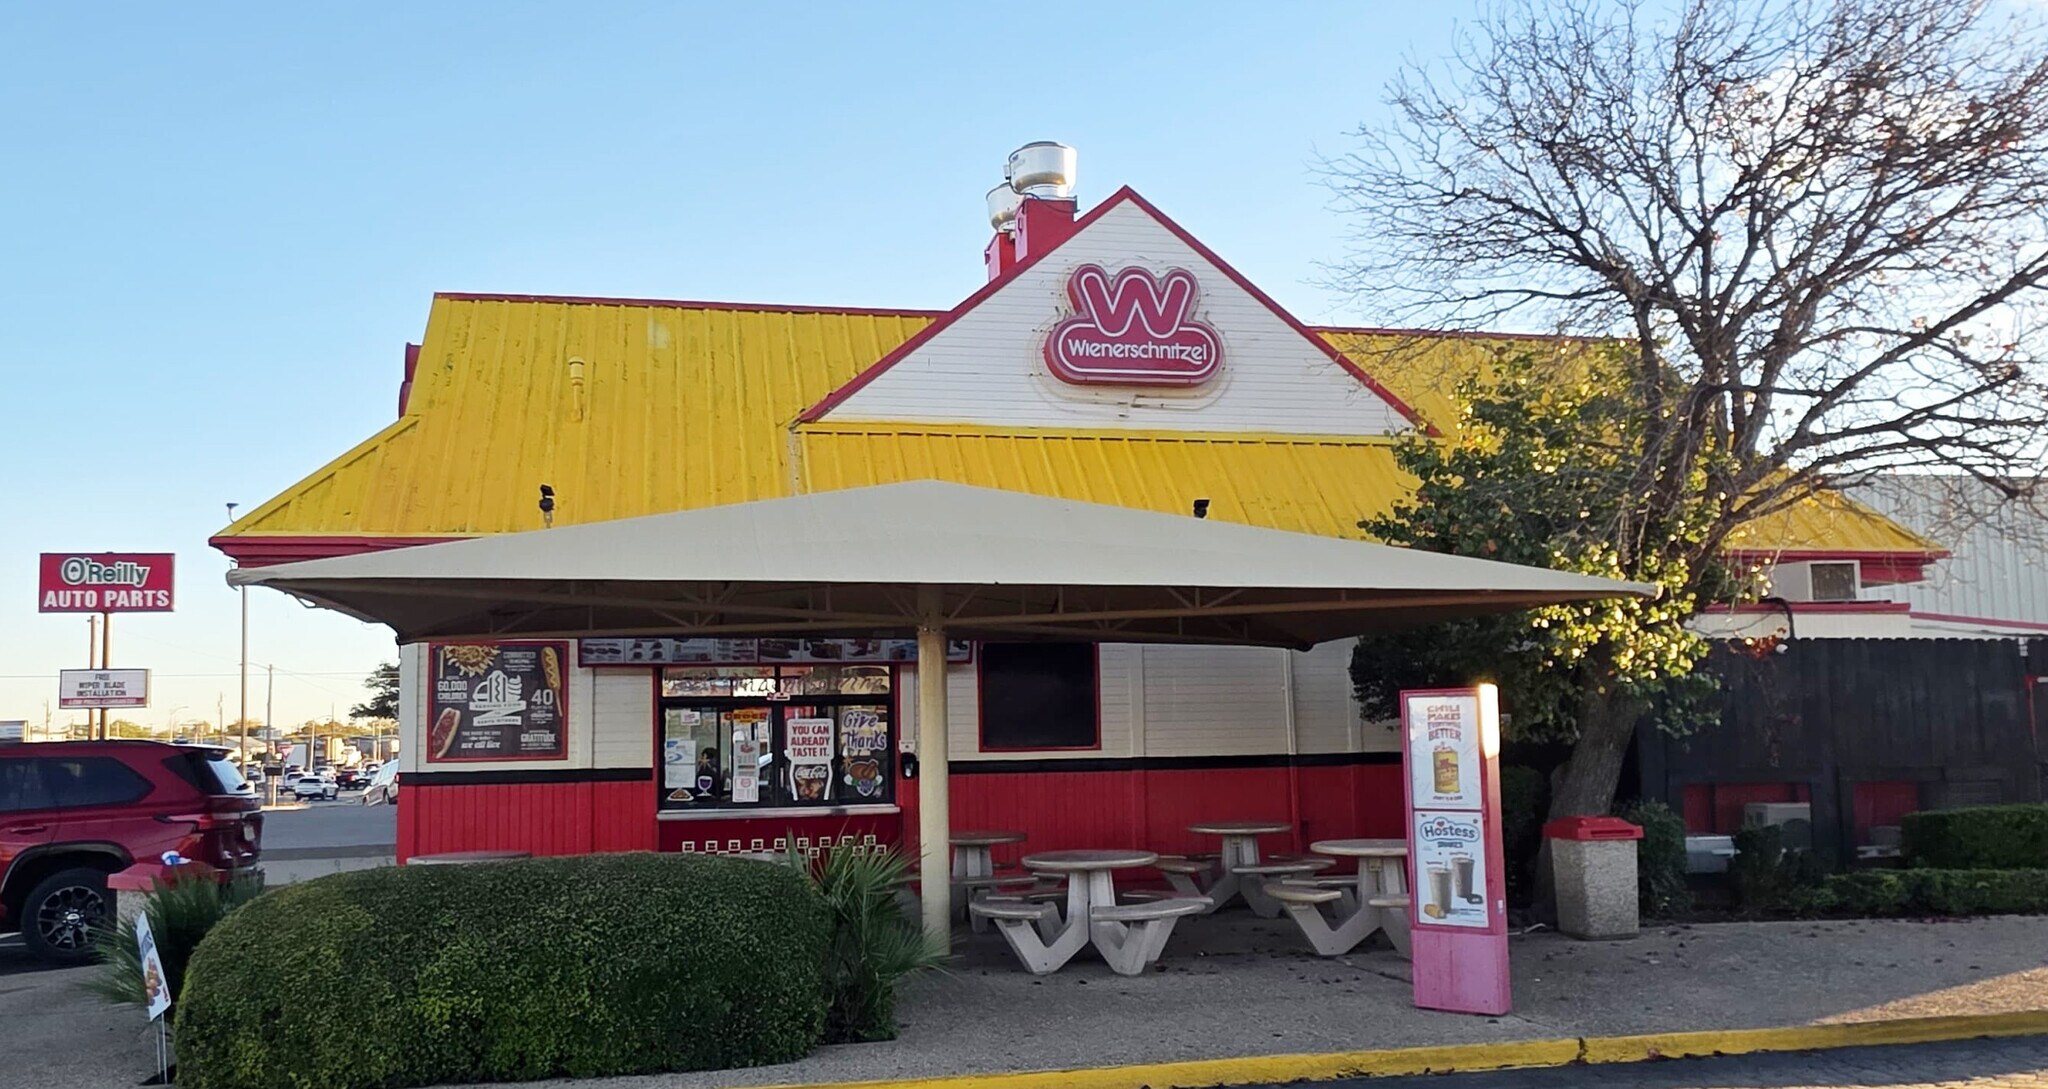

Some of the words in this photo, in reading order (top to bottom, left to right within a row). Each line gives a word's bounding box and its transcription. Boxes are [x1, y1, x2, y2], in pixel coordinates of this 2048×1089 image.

[1080, 272, 1191, 339] W
[1067, 338, 1207, 365] Wienerschnitzel
[62, 557, 149, 587] O'Reilly
[44, 590, 97, 608] AUTO
[104, 589, 169, 607] PARTS
[531, 689, 553, 705] 40
[844, 712, 878, 728] Give
[792, 725, 810, 734] YOU
[812, 725, 829, 734] CAN
[1428, 728, 1461, 742] BETTER
[791, 737, 830, 746] ALREADY
[792, 748, 817, 757] TASTE
[819, 748, 829, 757] IT.
[1424, 825, 1475, 839] Hostess
